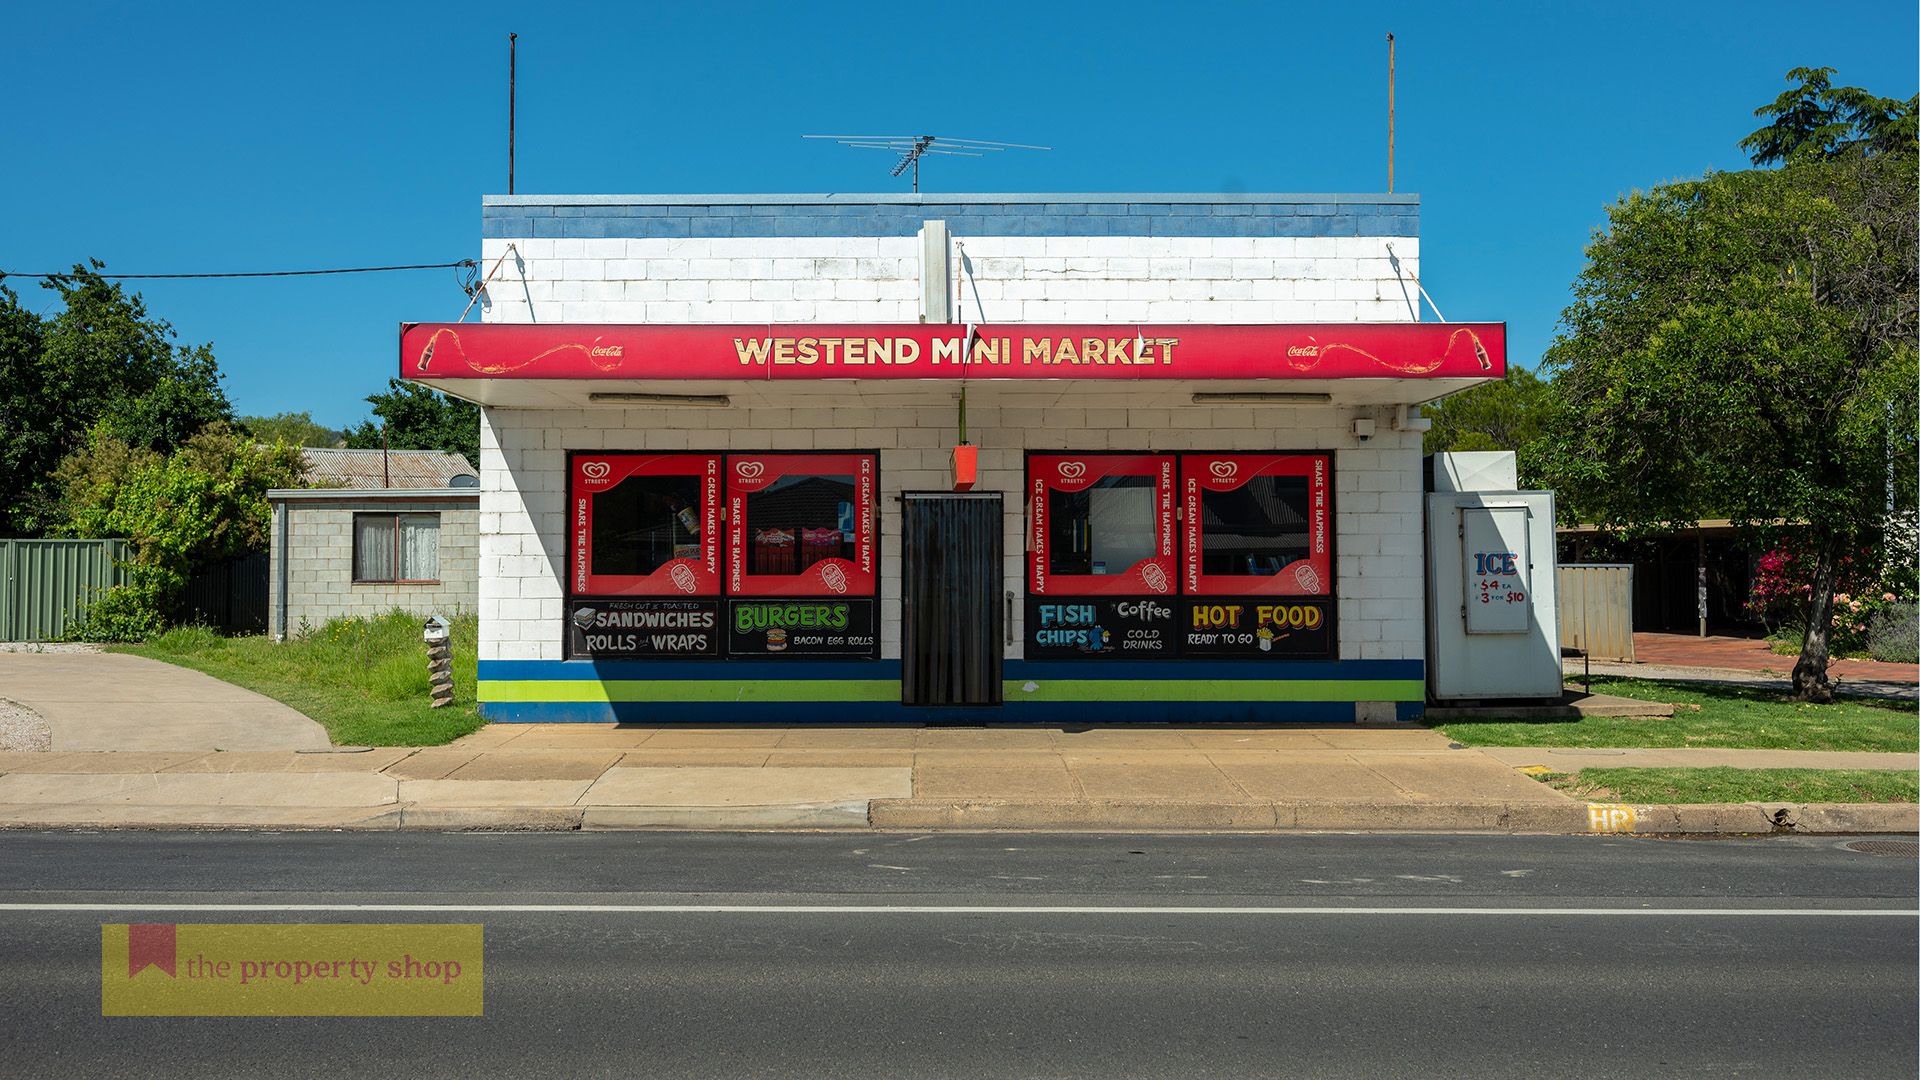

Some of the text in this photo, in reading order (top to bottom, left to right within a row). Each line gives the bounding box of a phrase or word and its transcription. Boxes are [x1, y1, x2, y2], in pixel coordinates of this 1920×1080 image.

[733, 337, 1179, 365] WESTEND MINI MARKET
[707, 459, 716, 475] ICE
[861, 459, 870, 474] ICE
[707, 477, 716, 506] CREAM
[861, 476, 870, 505] CREAM
[1035, 479, 1043, 494] ICE
[1188, 478, 1196, 493] ICE
[1035, 496, 1043, 525] CREAM
[1162, 462, 1171, 556] SHARE THE HAPPINESS
[1188, 495, 1196, 524] CREAM
[1315, 460, 1324, 554] SHARE THE HAPPINESS
[707, 508, 716, 535] MAKES
[861, 507, 870, 535] MAKES
[578, 498, 586, 592] SHARE THE HAPPINESS
[732, 497, 741, 592] SHARE THE HAPPINESS
[1036, 527, 1044, 554] MAKES
[1188, 526, 1196, 553] MAKES
[707, 545, 716, 574] HAPPY
[861, 545, 870, 573] HAPPY
[1473, 552, 1518, 576] ICE
[1036, 564, 1044, 593] HAPPY
[1189, 564, 1197, 592] HAPPY
[1480, 579, 1499, 591] $4
[635, 602, 651, 610] CUT
[663, 602, 700, 610] TOASTED
[1481, 592, 1490, 603] 3
[1506, 591, 1525, 604] $10
[595, 611, 715, 628] SANDWICHES
[736, 605, 849, 631] BURGERS
[1038, 604, 1096, 626] FISH
[1117, 600, 1171, 622] Coffee
[1192, 605, 1323, 629] HOT FOOD
[586, 635, 637, 651] ROLLS
[651, 634, 708, 651] WRAPS
[793, 636, 874, 646] BACON EGG ROLLS
[1035, 629, 1087, 646] CHIPS
[1122, 640, 1163, 650] DRINKS
[1127, 629, 1160, 639] COLD
[1187, 633, 1253, 645] READY TO GO
